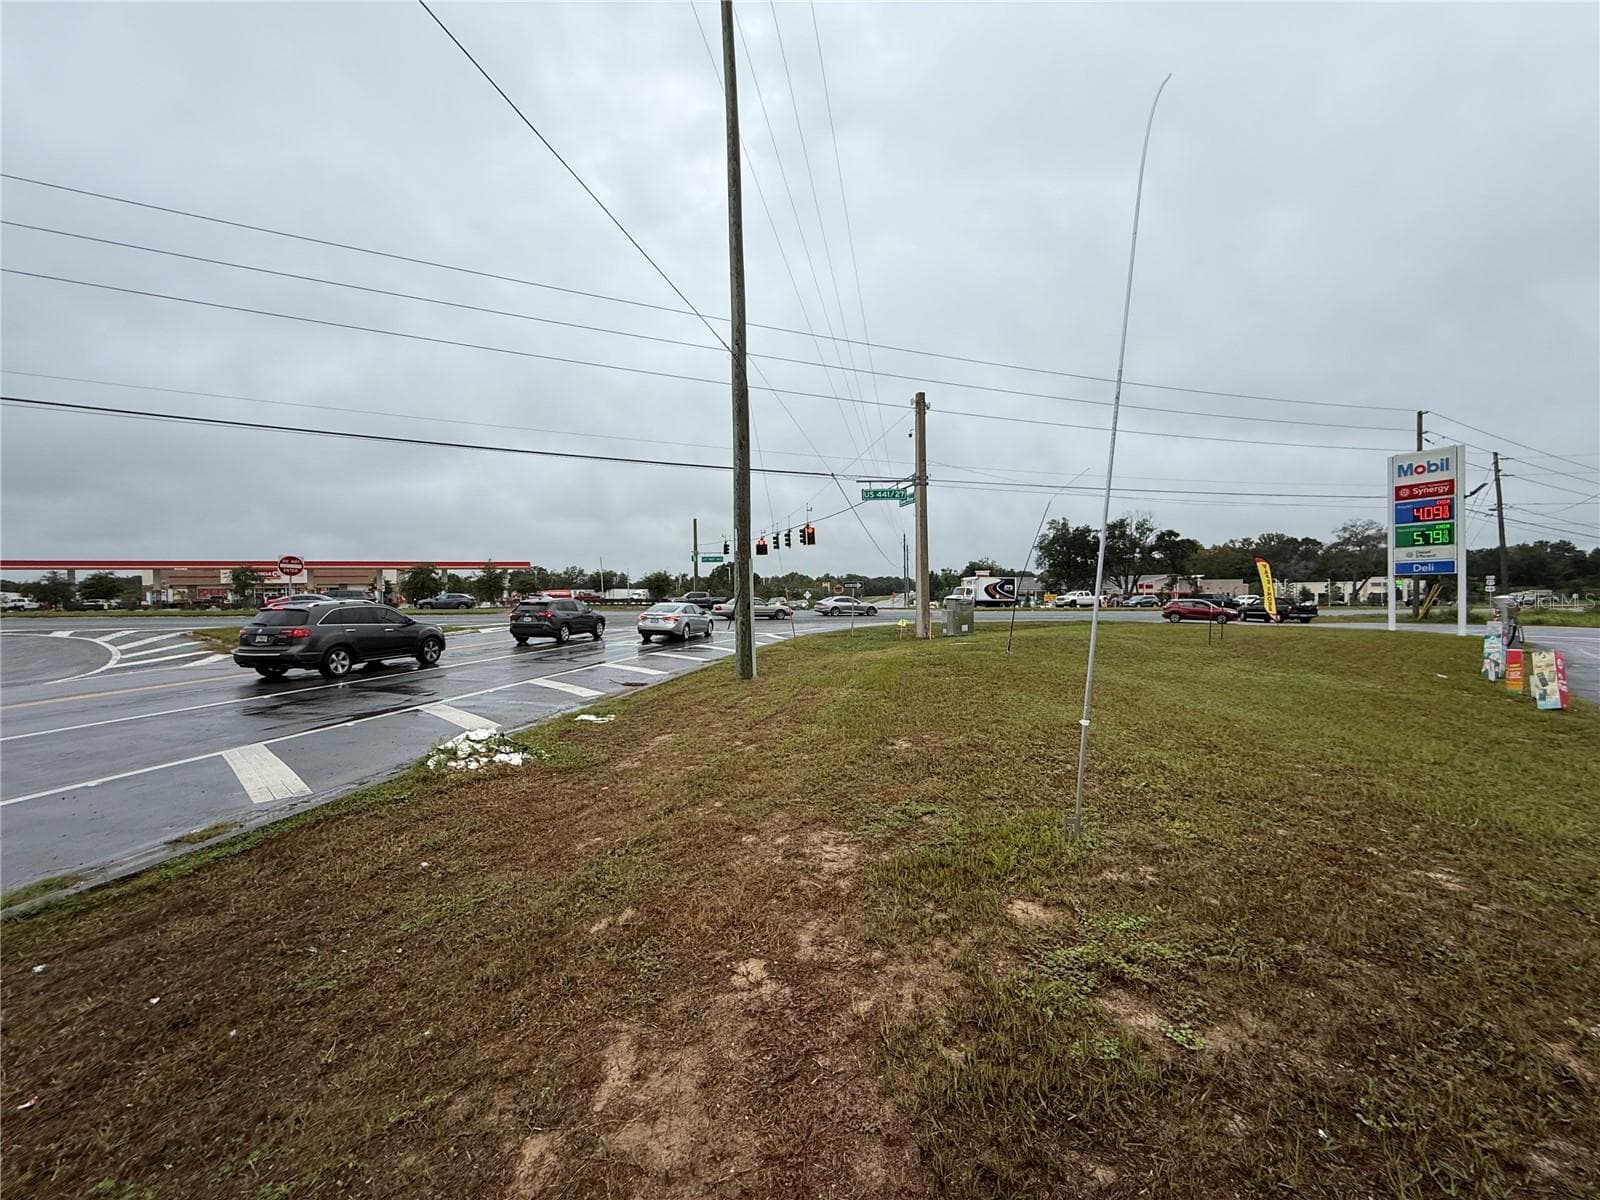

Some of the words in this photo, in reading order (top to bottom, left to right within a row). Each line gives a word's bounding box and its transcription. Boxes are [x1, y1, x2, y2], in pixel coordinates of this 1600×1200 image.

[1397, 457, 1450, 478] Mobil
[1412, 485, 1450, 496] Synergy
[1412, 563, 1435, 572] Deli
